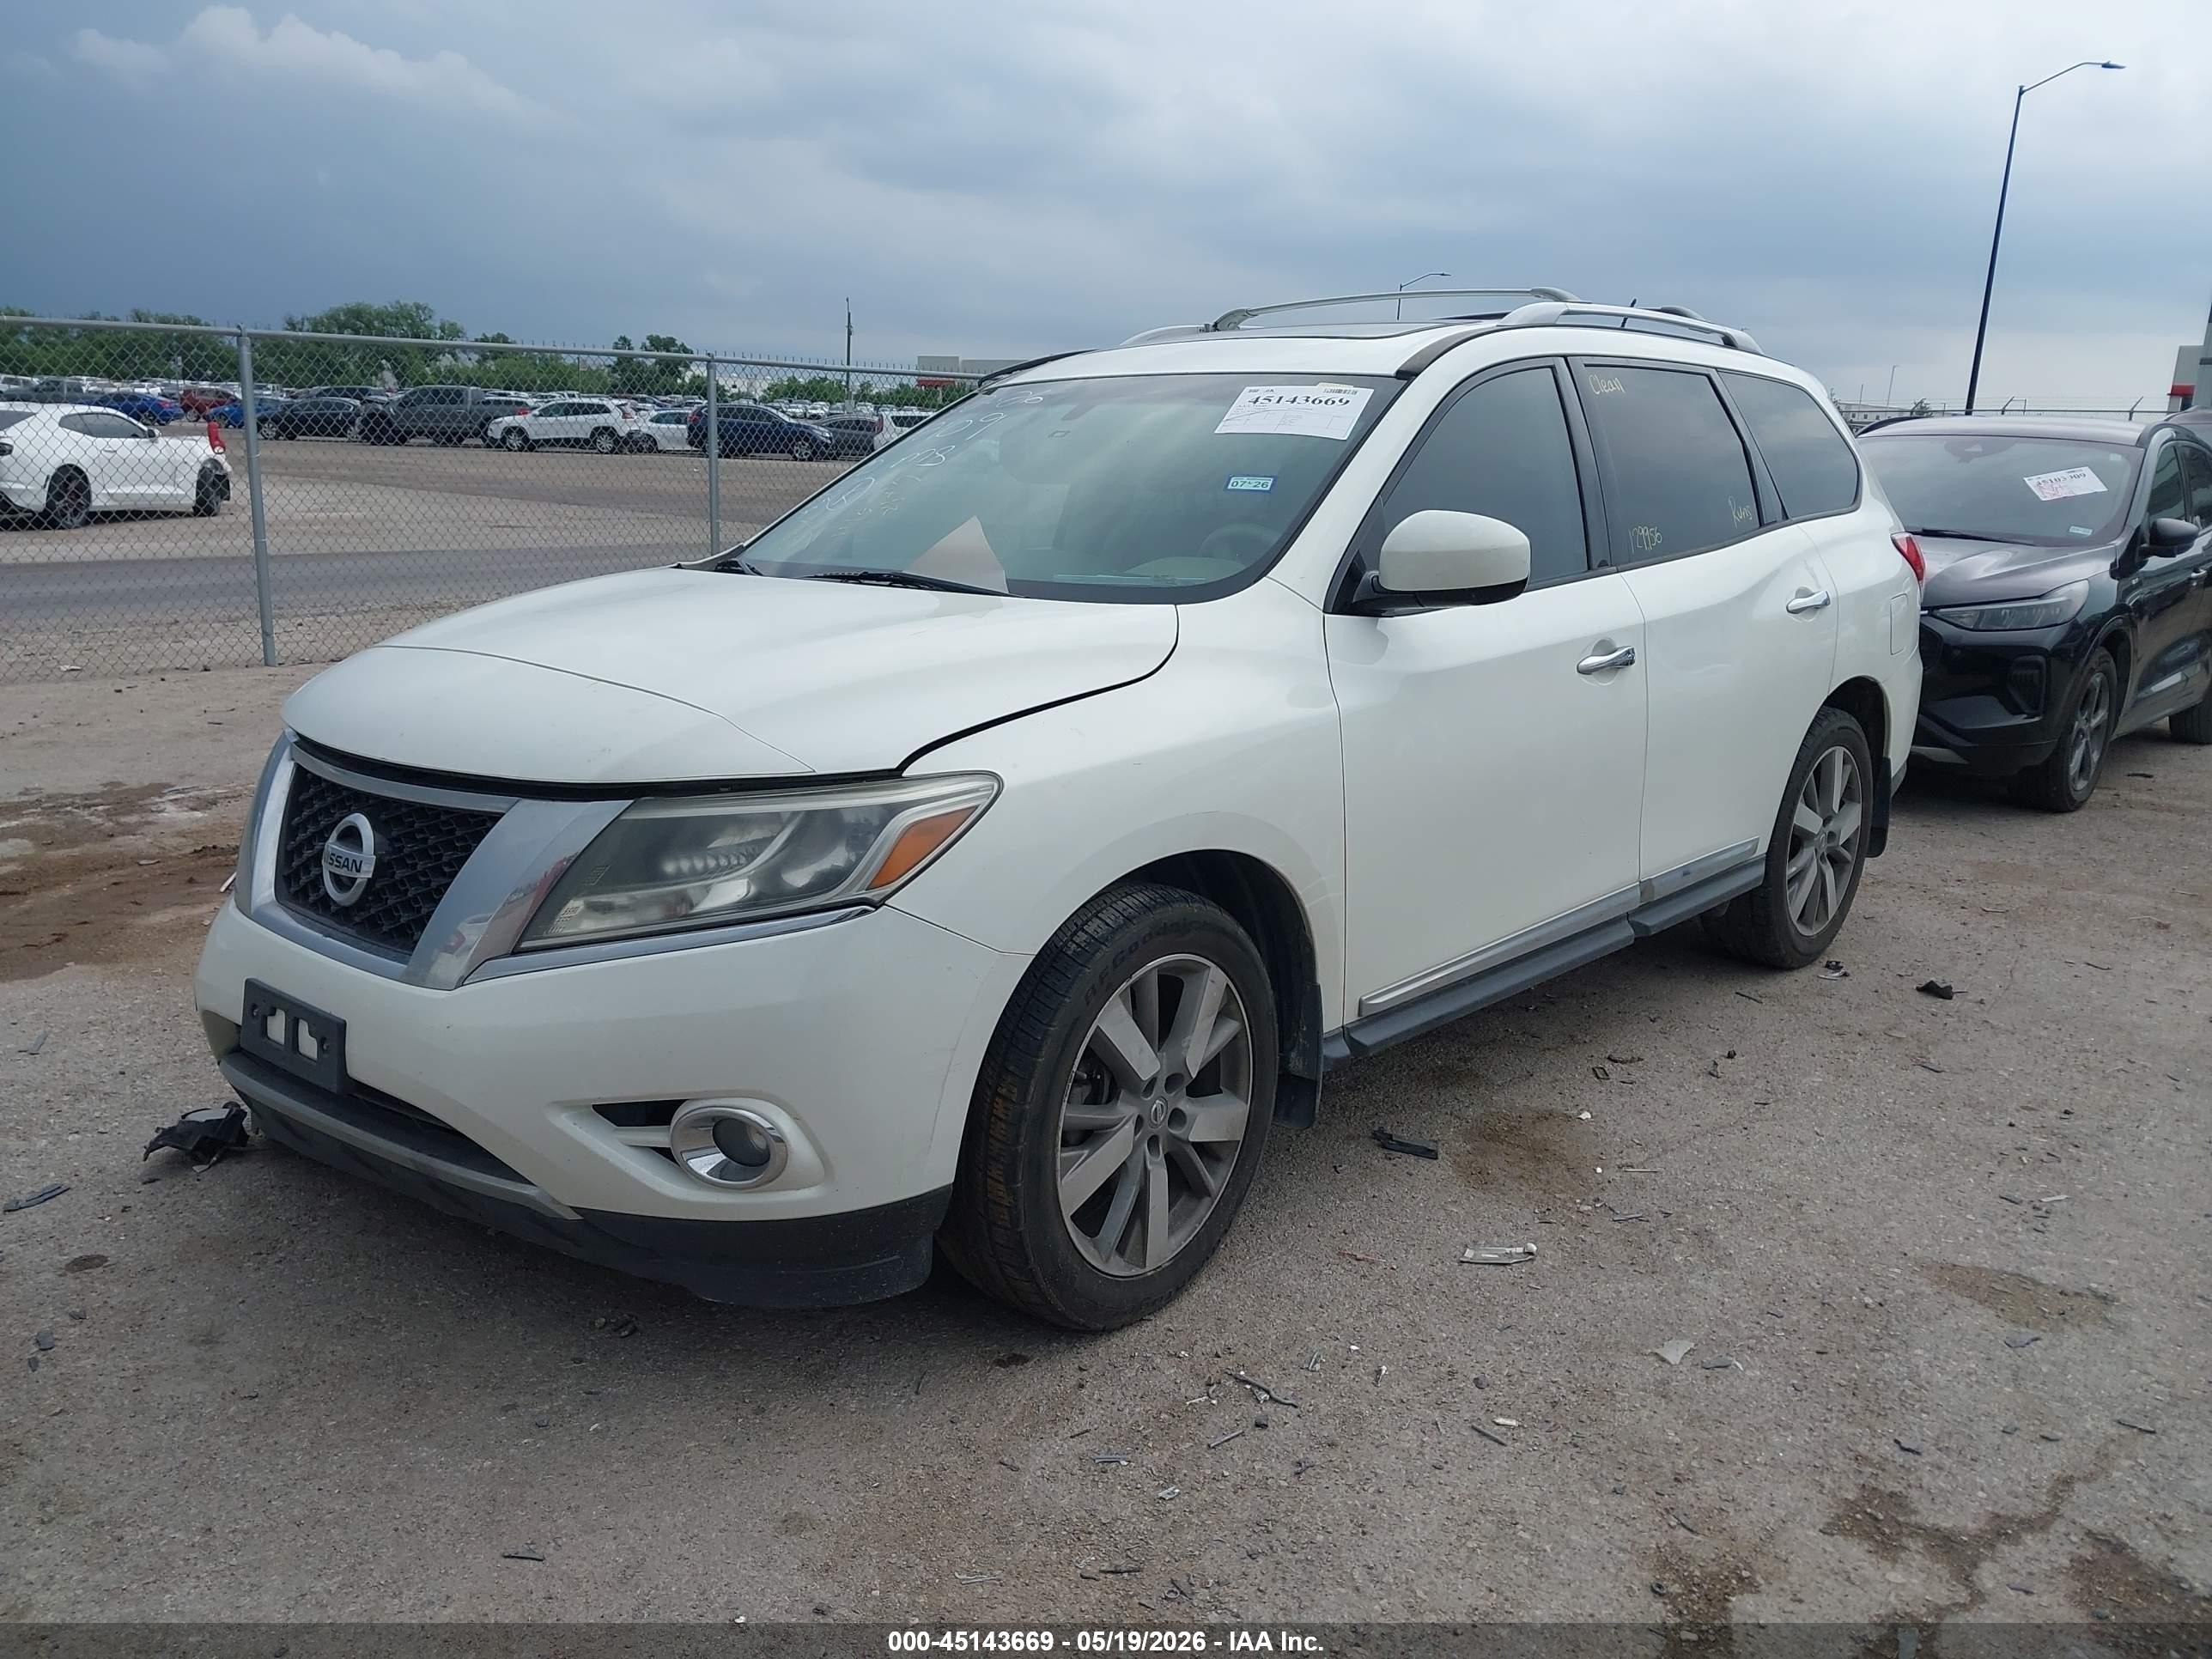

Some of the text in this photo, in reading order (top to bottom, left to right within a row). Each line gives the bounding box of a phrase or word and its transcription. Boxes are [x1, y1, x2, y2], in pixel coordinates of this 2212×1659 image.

[1589, 374, 1626, 395] Clean
[1248, 395, 1351, 407] 45143669
[1728, 495, 1753, 529] Runs
